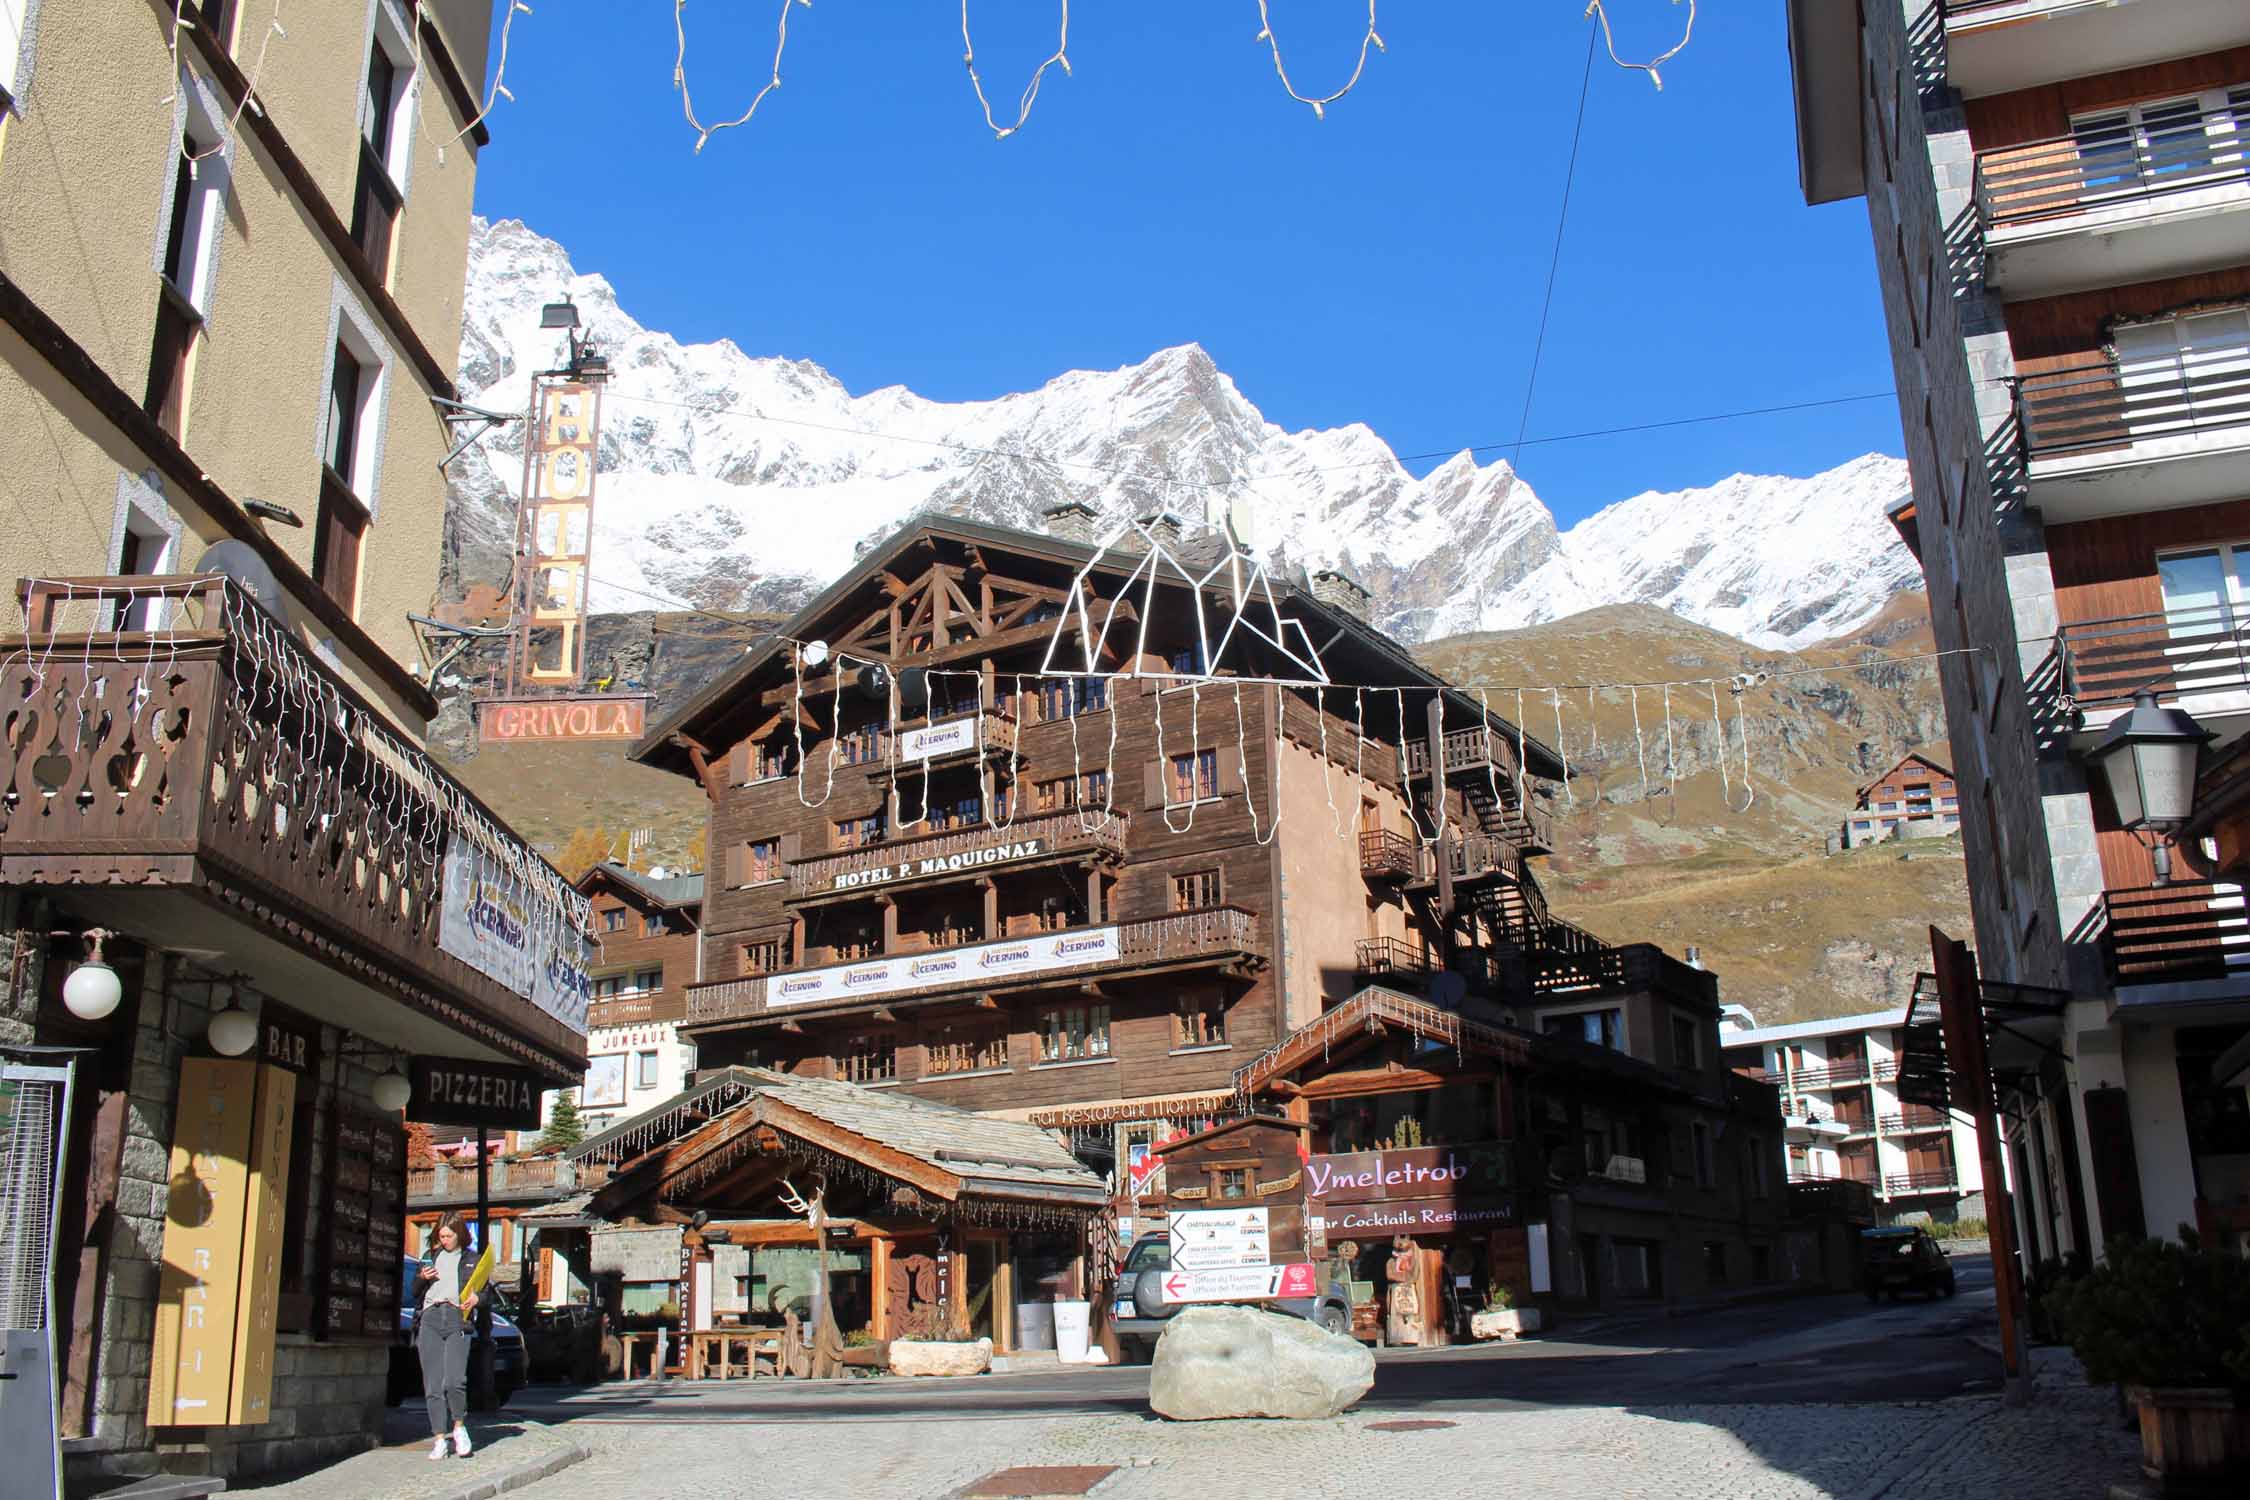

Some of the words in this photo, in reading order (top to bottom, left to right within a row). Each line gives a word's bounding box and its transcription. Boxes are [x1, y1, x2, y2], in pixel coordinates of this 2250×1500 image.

[497, 705, 633, 739] GRIVOLA
[835, 867, 893, 889] HOTEL
[899, 864, 912, 878] P.
[920, 840, 1039, 875] MAQUIGNAZ
[990, 950, 1030, 964] CERVINO
[1064, 939, 1105, 953] CERVINO
[852, 971, 889, 984] CERVINO
[919, 961, 957, 974] CERVINO
[788, 980, 823, 993] CERVINO
[268, 1024, 307, 1068] BAR
[602, 1030, 666, 1049] JUMEAUX
[430, 1070, 532, 1112] PIZZERIA
[1306, 1152, 1469, 1197] Ymeletrob
[1343, 1209, 1416, 1229] Cocktails
[1421, 1206, 1511, 1225] Restaurant
[681, 1248, 690, 1275] Bar
[187, 1247, 210, 1330] BAR
